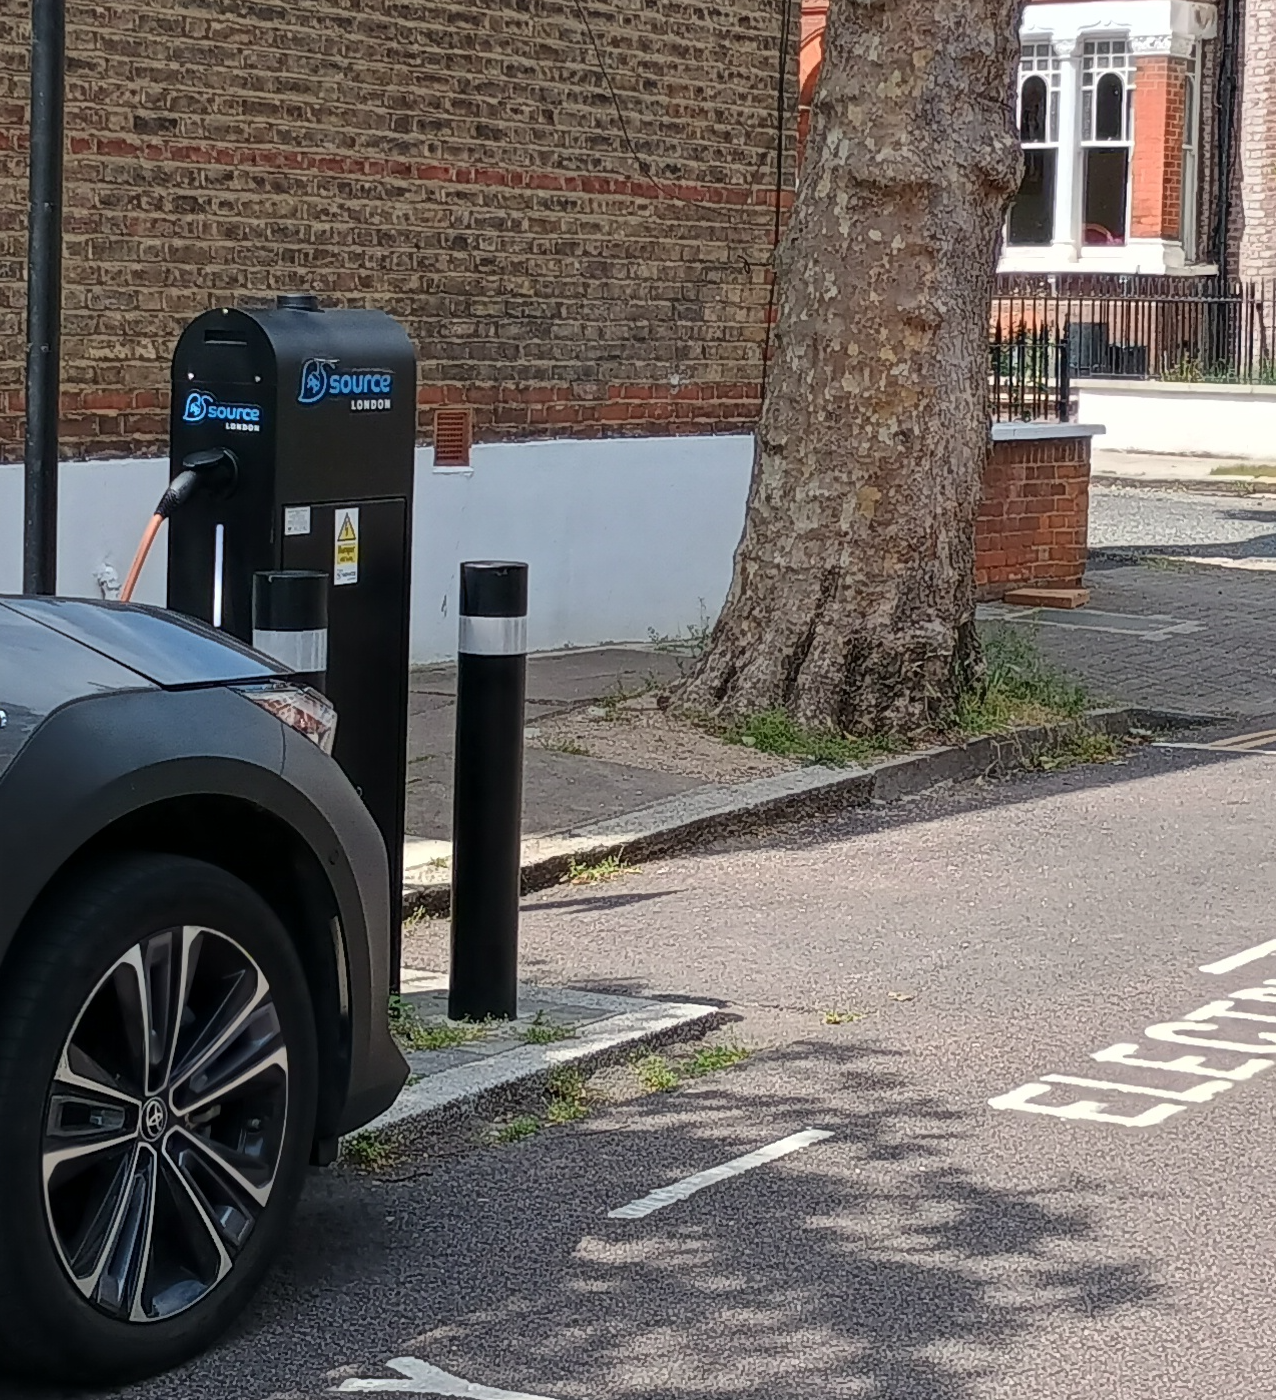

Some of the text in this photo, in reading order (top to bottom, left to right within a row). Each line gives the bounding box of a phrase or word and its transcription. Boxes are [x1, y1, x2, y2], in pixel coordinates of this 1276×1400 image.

[329, 374, 391, 394] source
[350, 399, 391, 411] LONDON
[207, 405, 260, 421] source
[225, 421, 261, 432] LONDON
